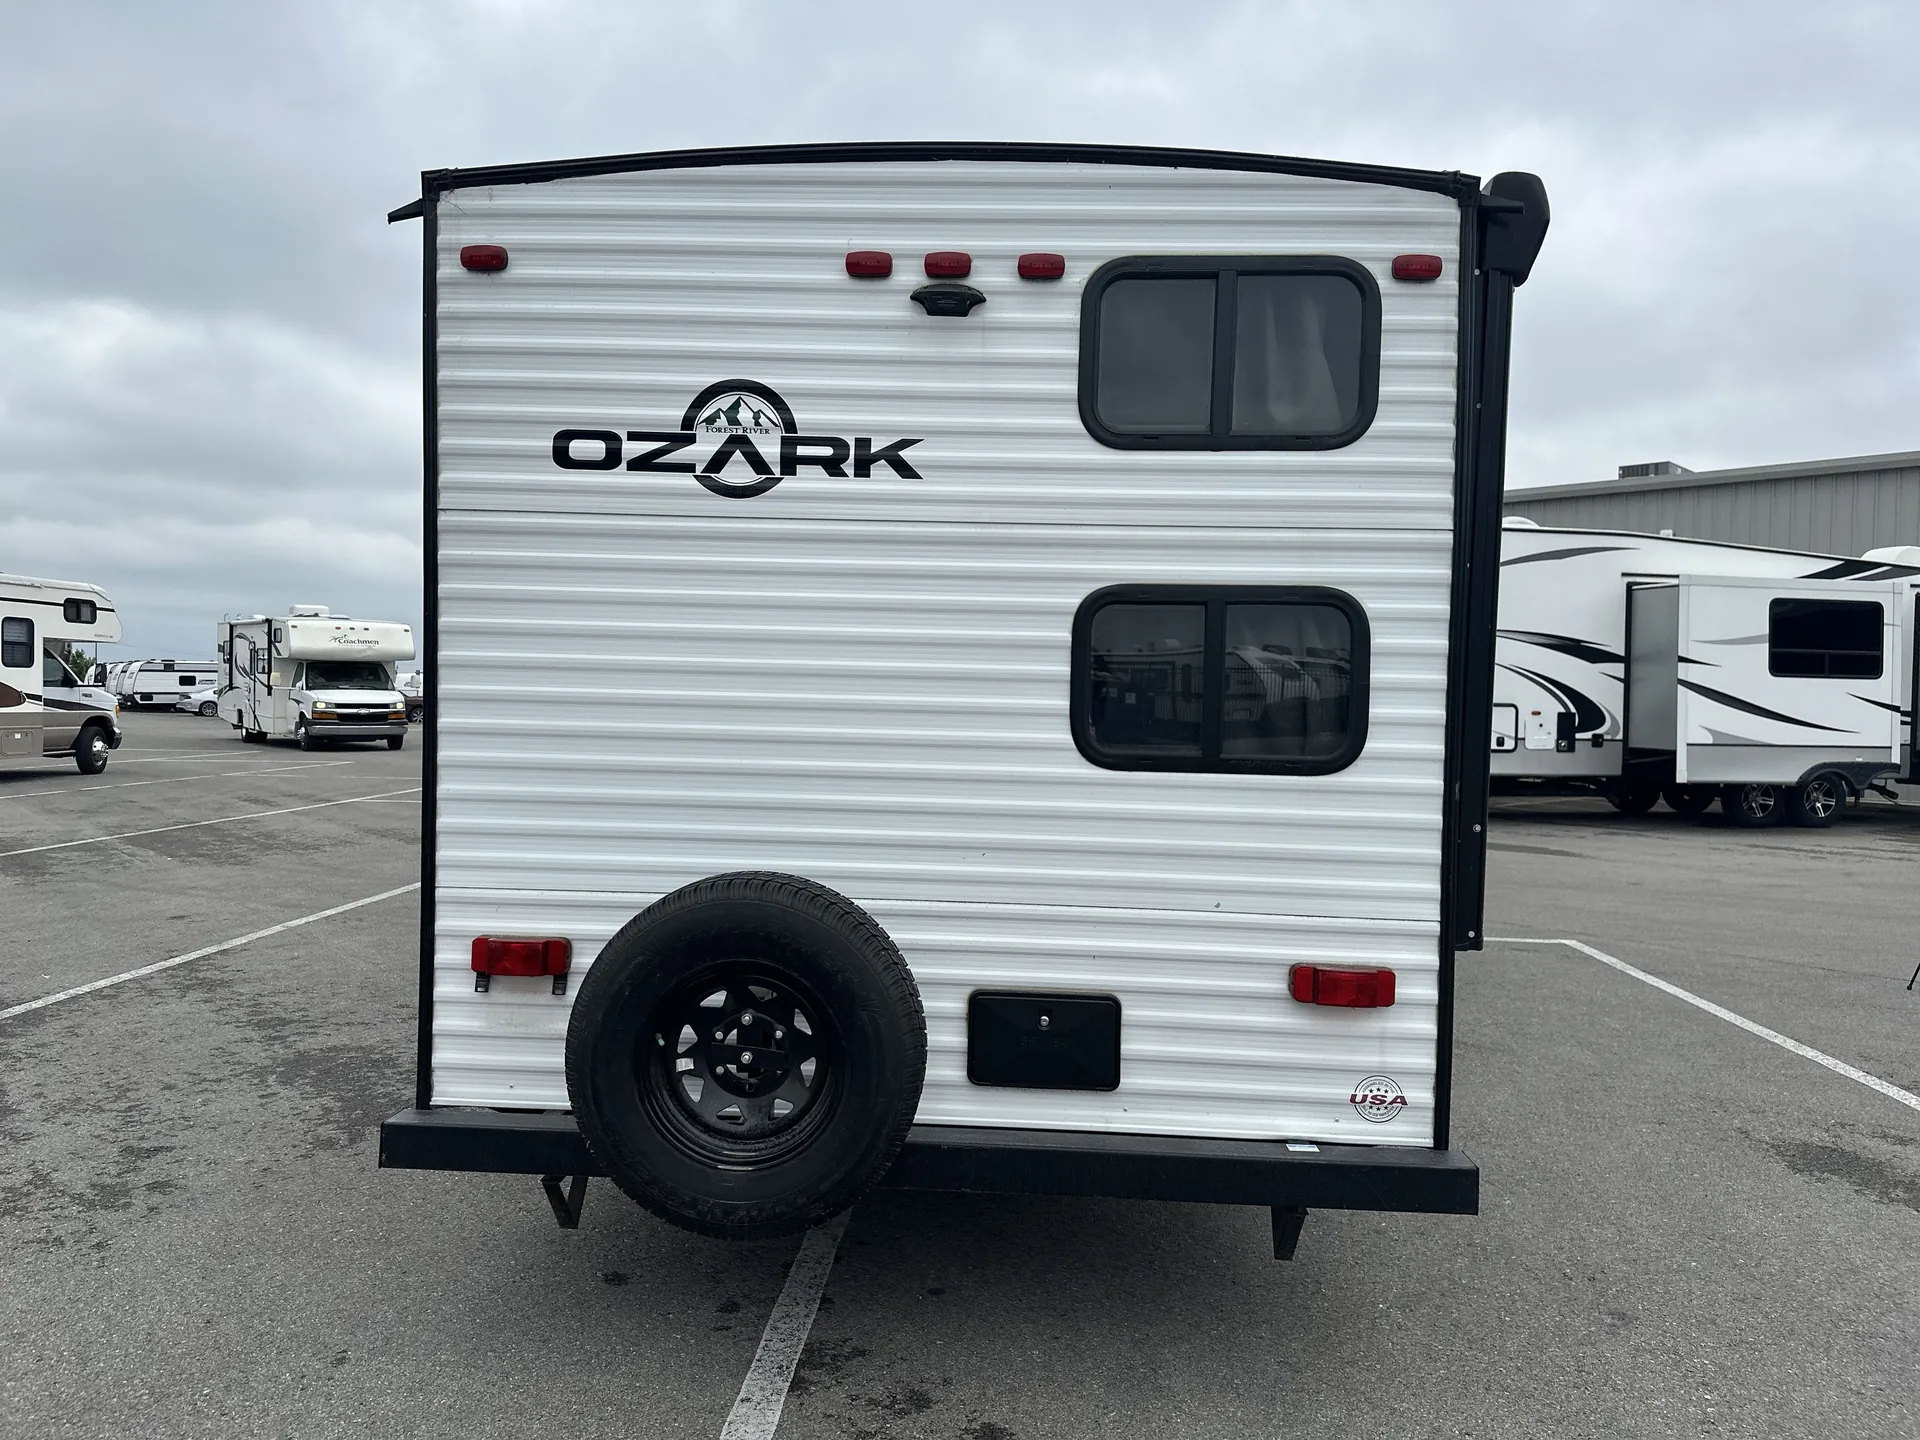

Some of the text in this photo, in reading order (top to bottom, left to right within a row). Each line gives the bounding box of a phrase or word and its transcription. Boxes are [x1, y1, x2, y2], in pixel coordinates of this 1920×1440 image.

[705, 425, 770, 435] FOREST RIVER
[552, 429, 925, 480] OZARK
[1349, 1094, 1409, 1106] USA
